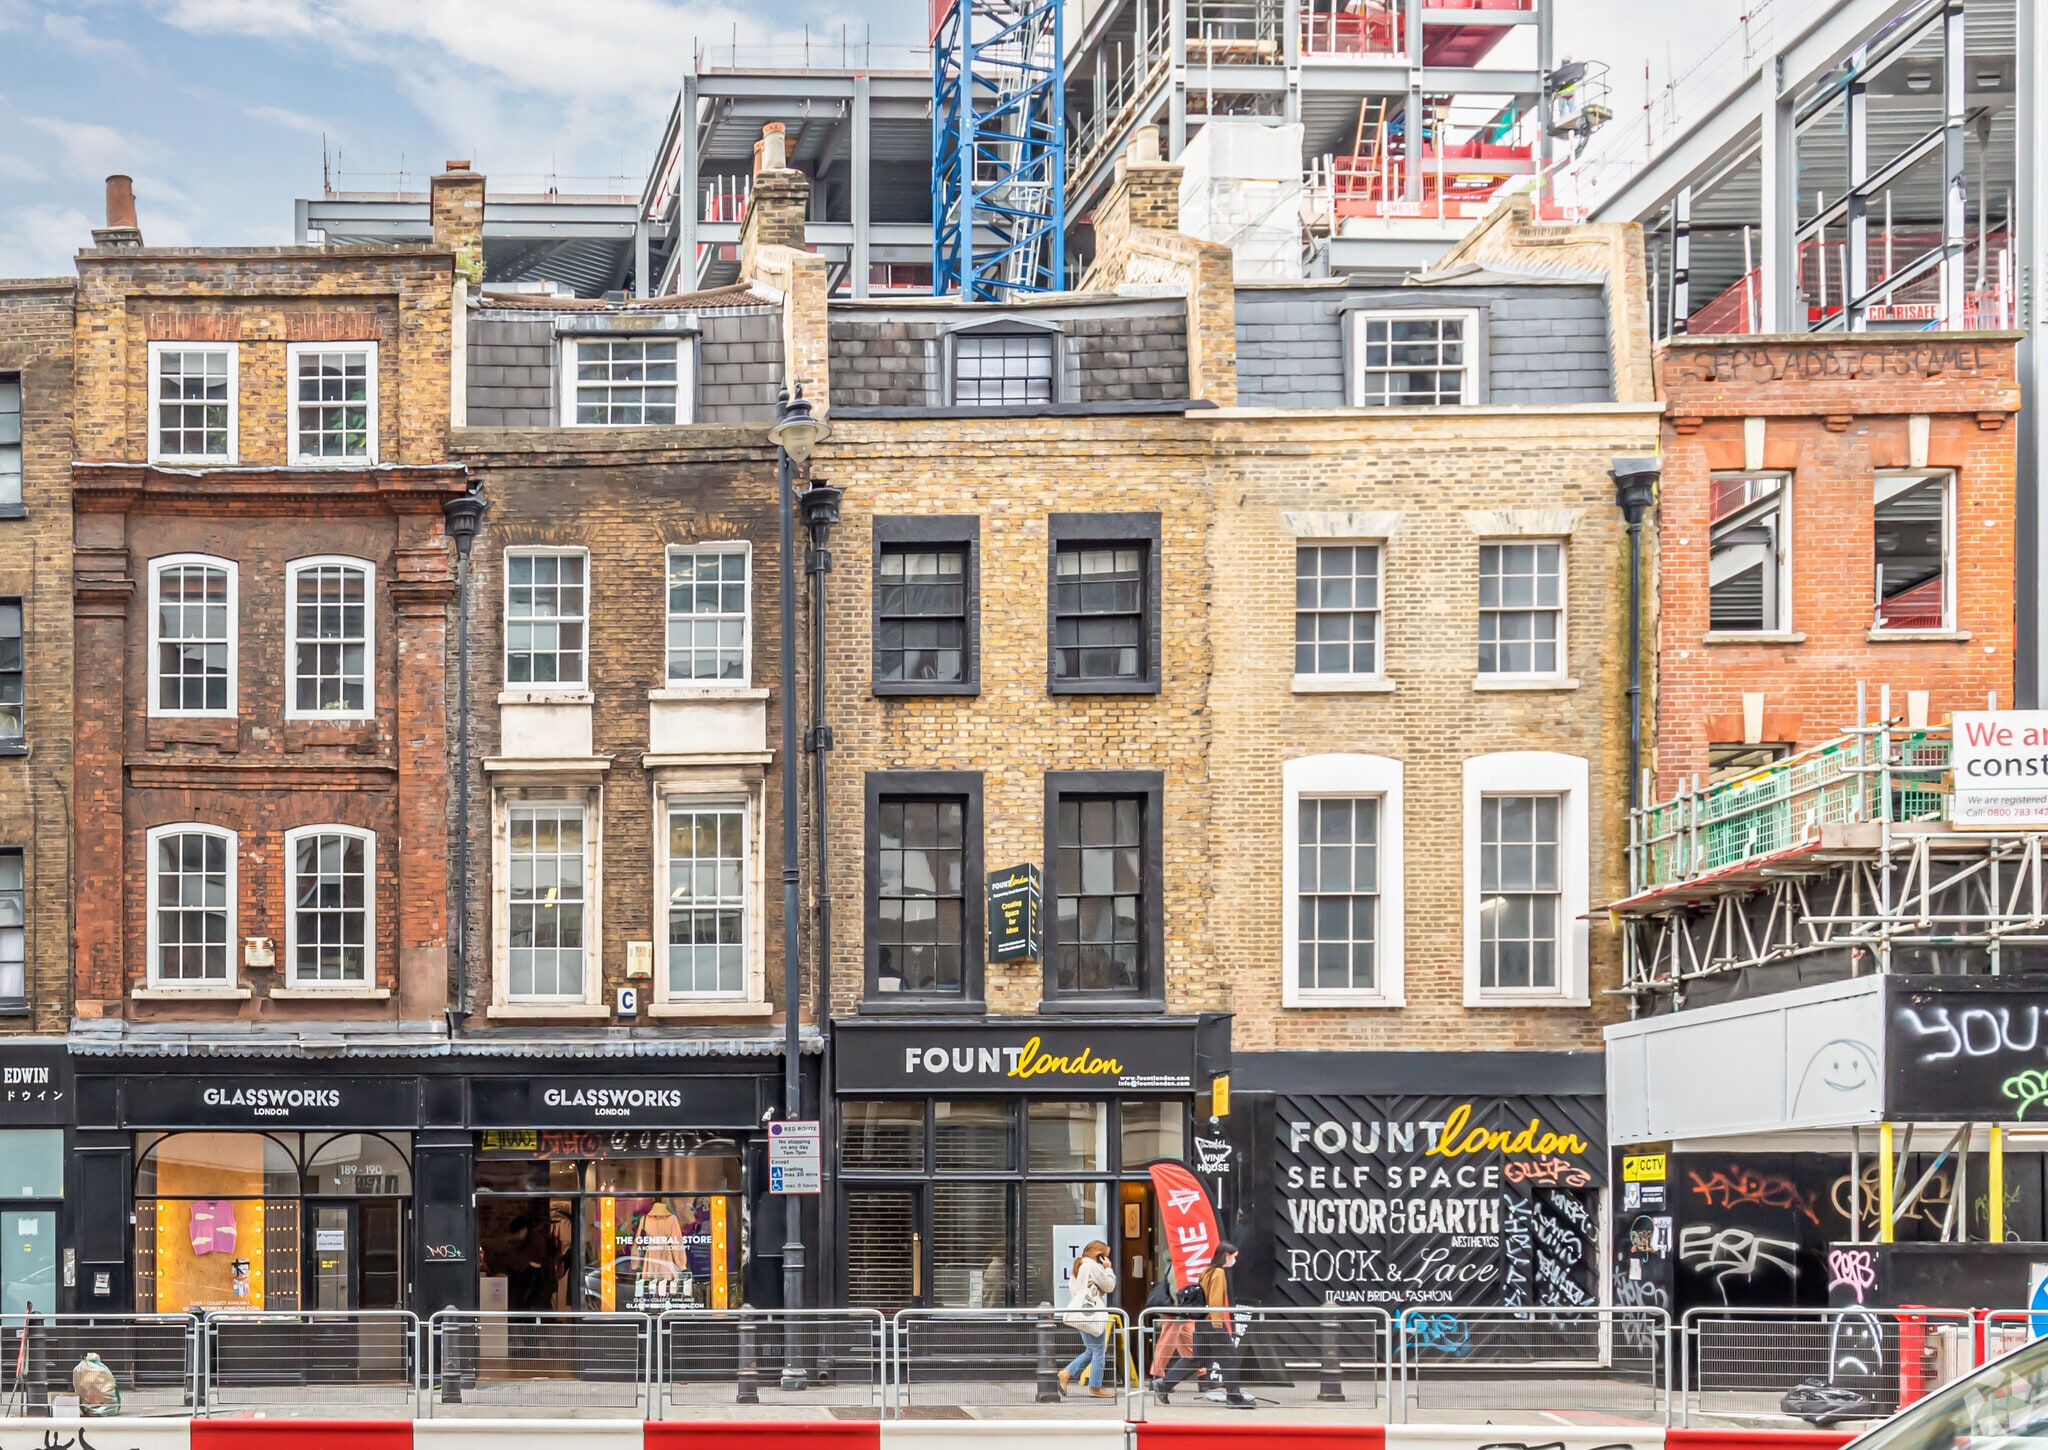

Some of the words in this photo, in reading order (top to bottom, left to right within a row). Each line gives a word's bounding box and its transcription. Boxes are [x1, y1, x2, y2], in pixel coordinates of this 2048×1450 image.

[1965, 722, 2013, 747] We
[1968, 796, 1982, 804] We
[2001, 796, 2046, 805] registered
[2014, 808, 2030, 816] 783
[622, 992, 633, 1009] C
[905, 1047, 1023, 1073] FOUNT
[1008, 1036, 1123, 1078] london
[4, 1067, 49, 1084] EDWIN
[204, 1088, 340, 1107] GLASSWORKS
[544, 1088, 681, 1107] GLASSWORKS
[254, 1108, 289, 1116] LONDON
[595, 1108, 630, 1116] LONDON
[1290, 1121, 1444, 1154] FOUNT
[1425, 1104, 1588, 1156] london
[341, 1165, 357, 1174] 189
[366, 1165, 382, 1174] 190
[1197, 1164, 1230, 1172] HOUSE
[1640, 1158, 1663, 1170] CCTV
[1287, 1166, 1370, 1188] SELF
[1388, 1166, 1499, 1188] SPACE
[636, 1236, 679, 1244] GENERAL
[682, 1236, 712, 1244] STORE
[1452, 1236, 1498, 1248] AESTHETICS
[1287, 1249, 1382, 1282] ROCK
[1387, 1267, 1402, 1282] &
[1403, 1248, 1500, 1287] Lace
[1326, 1290, 1364, 1302] ITALIAN
[1367, 1290, 1402, 1302] BRIDAL
[1406, 1290, 1452, 1302] FASHION
